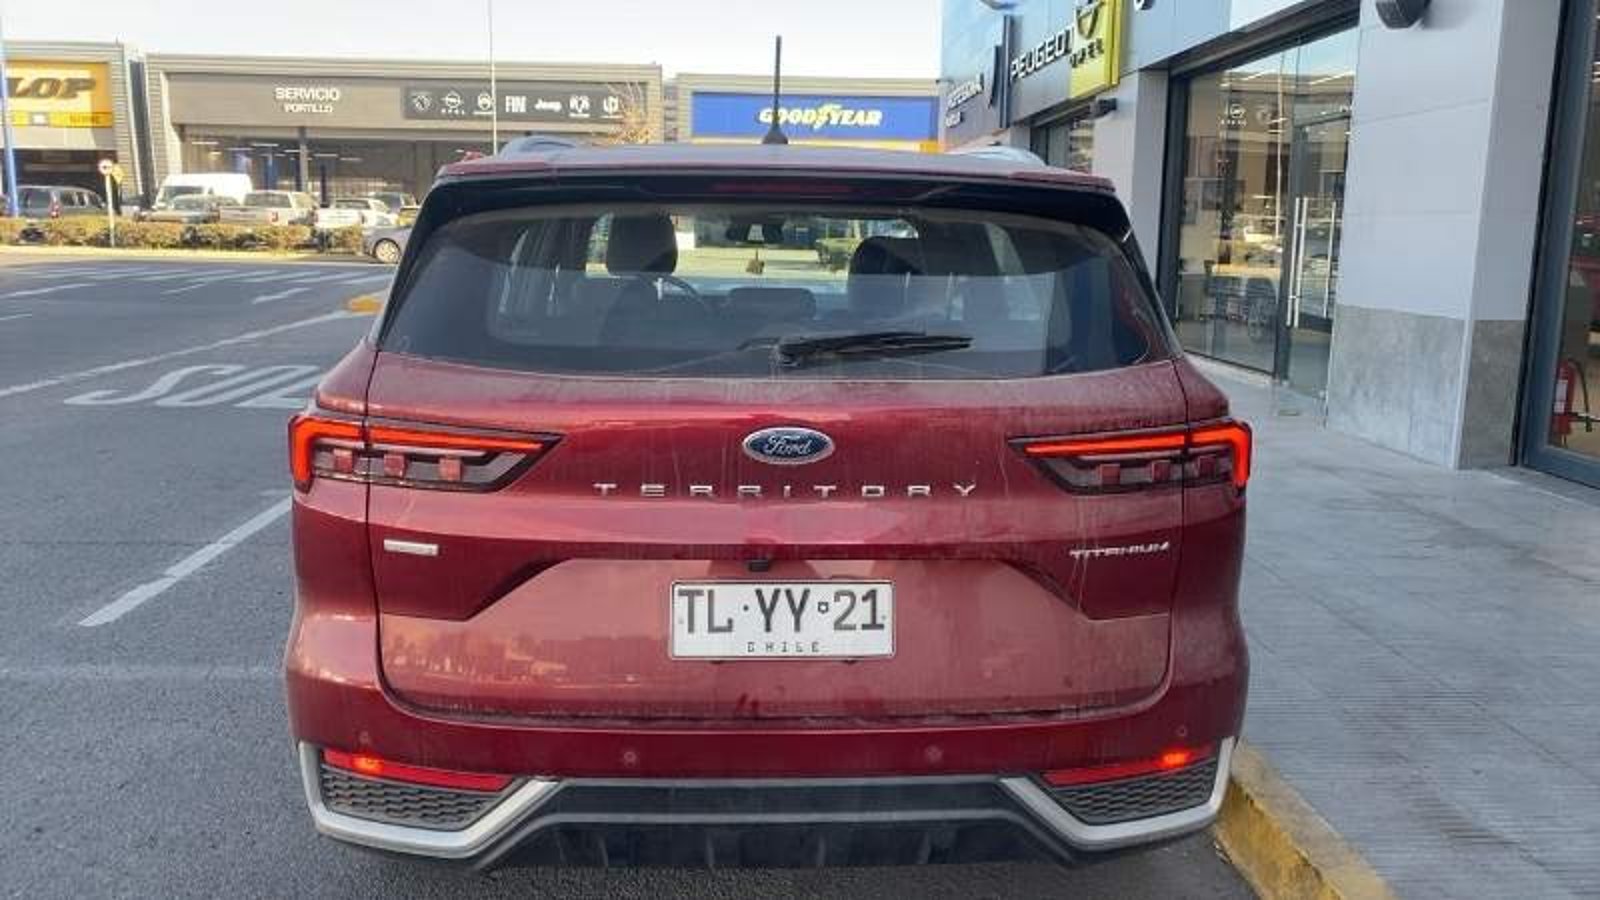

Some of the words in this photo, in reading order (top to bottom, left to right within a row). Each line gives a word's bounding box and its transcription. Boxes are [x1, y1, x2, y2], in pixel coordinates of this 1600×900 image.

[1011, 24, 1074, 80] PEUGEOT
[274, 87, 341, 101] SERVICIO
[593, 482, 977, 498] TERRITORY
[1069, 541, 1170, 560] TITANIUM
[747, 641, 820, 653] CHILE
